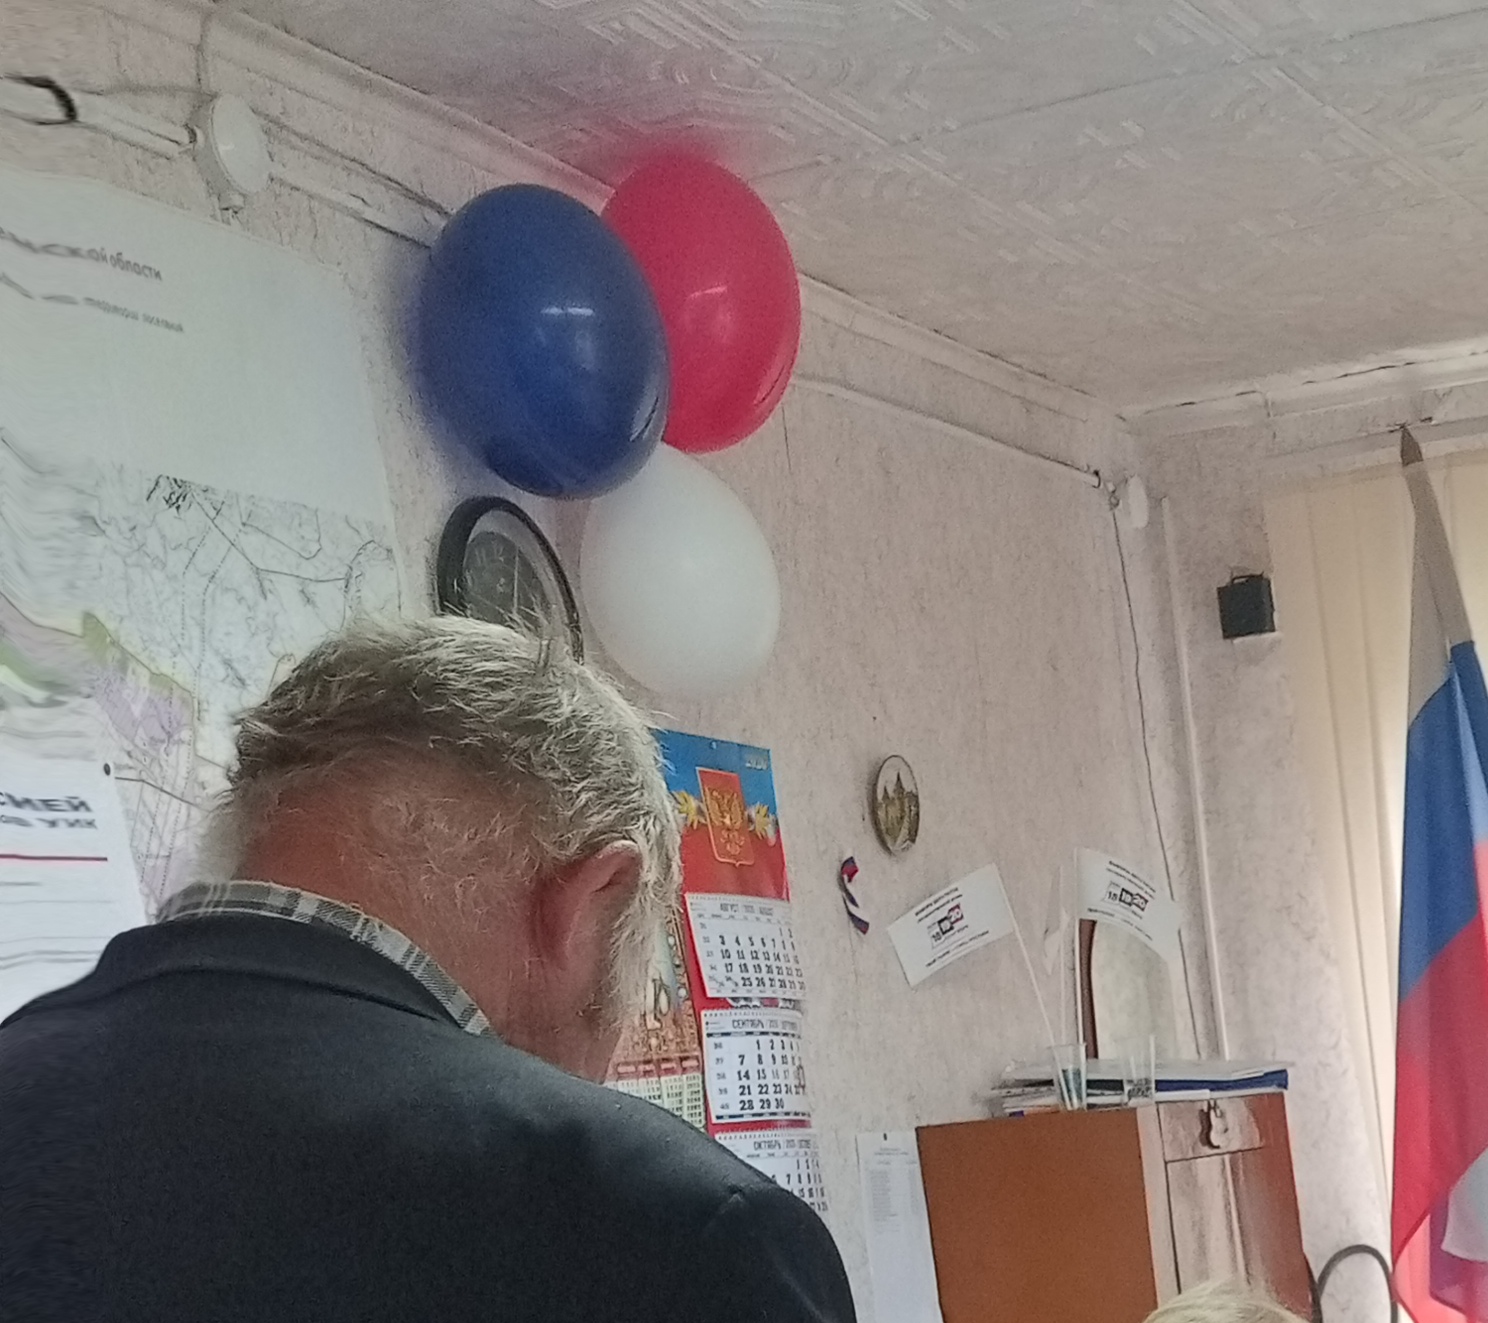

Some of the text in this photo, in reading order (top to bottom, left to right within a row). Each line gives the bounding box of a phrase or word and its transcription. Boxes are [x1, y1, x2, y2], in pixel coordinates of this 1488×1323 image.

[736, 1068, 751, 1082] 14
[756, 1068, 767, 1081] 15
[738, 1084, 752, 1096] 21
[757, 1083, 770, 1095] 22
[739, 1098, 755, 1112] 28
[759, 1098, 772, 1110] 29
